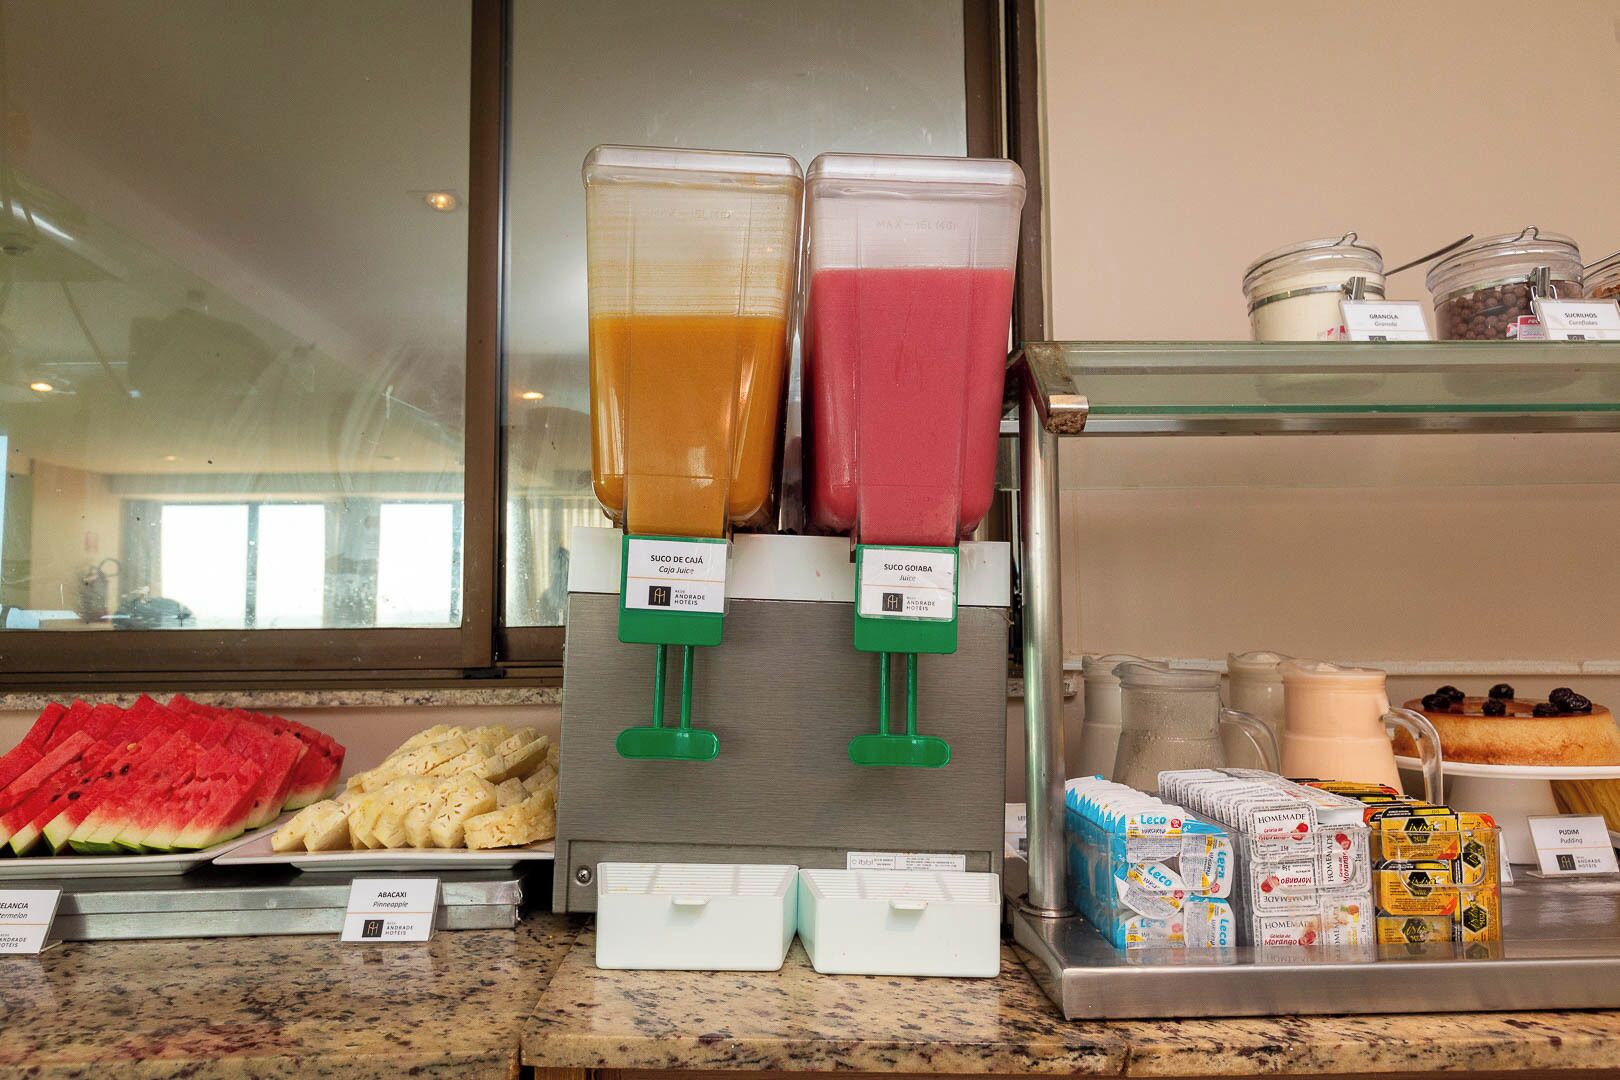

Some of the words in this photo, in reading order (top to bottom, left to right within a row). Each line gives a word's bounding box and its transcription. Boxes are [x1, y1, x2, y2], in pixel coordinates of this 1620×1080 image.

[650, 554, 672, 563] SUCO
[685, 556, 704, 564] CAJÁ
[676, 566, 695, 575] Juice
[884, 563, 904, 571] SUCO
[905, 564, 933, 573] GOIABA
[1140, 814, 1167, 825] Leco
[1258, 813, 1306, 824] HOMEMADE
[1147, 865, 1173, 887] Leco
[1280, 876, 1312, 885] Morango
[1263, 895, 1313, 903] HOMEMADE
[1219, 918, 1229, 946] Leco
[1264, 938, 1297, 946] Morango
